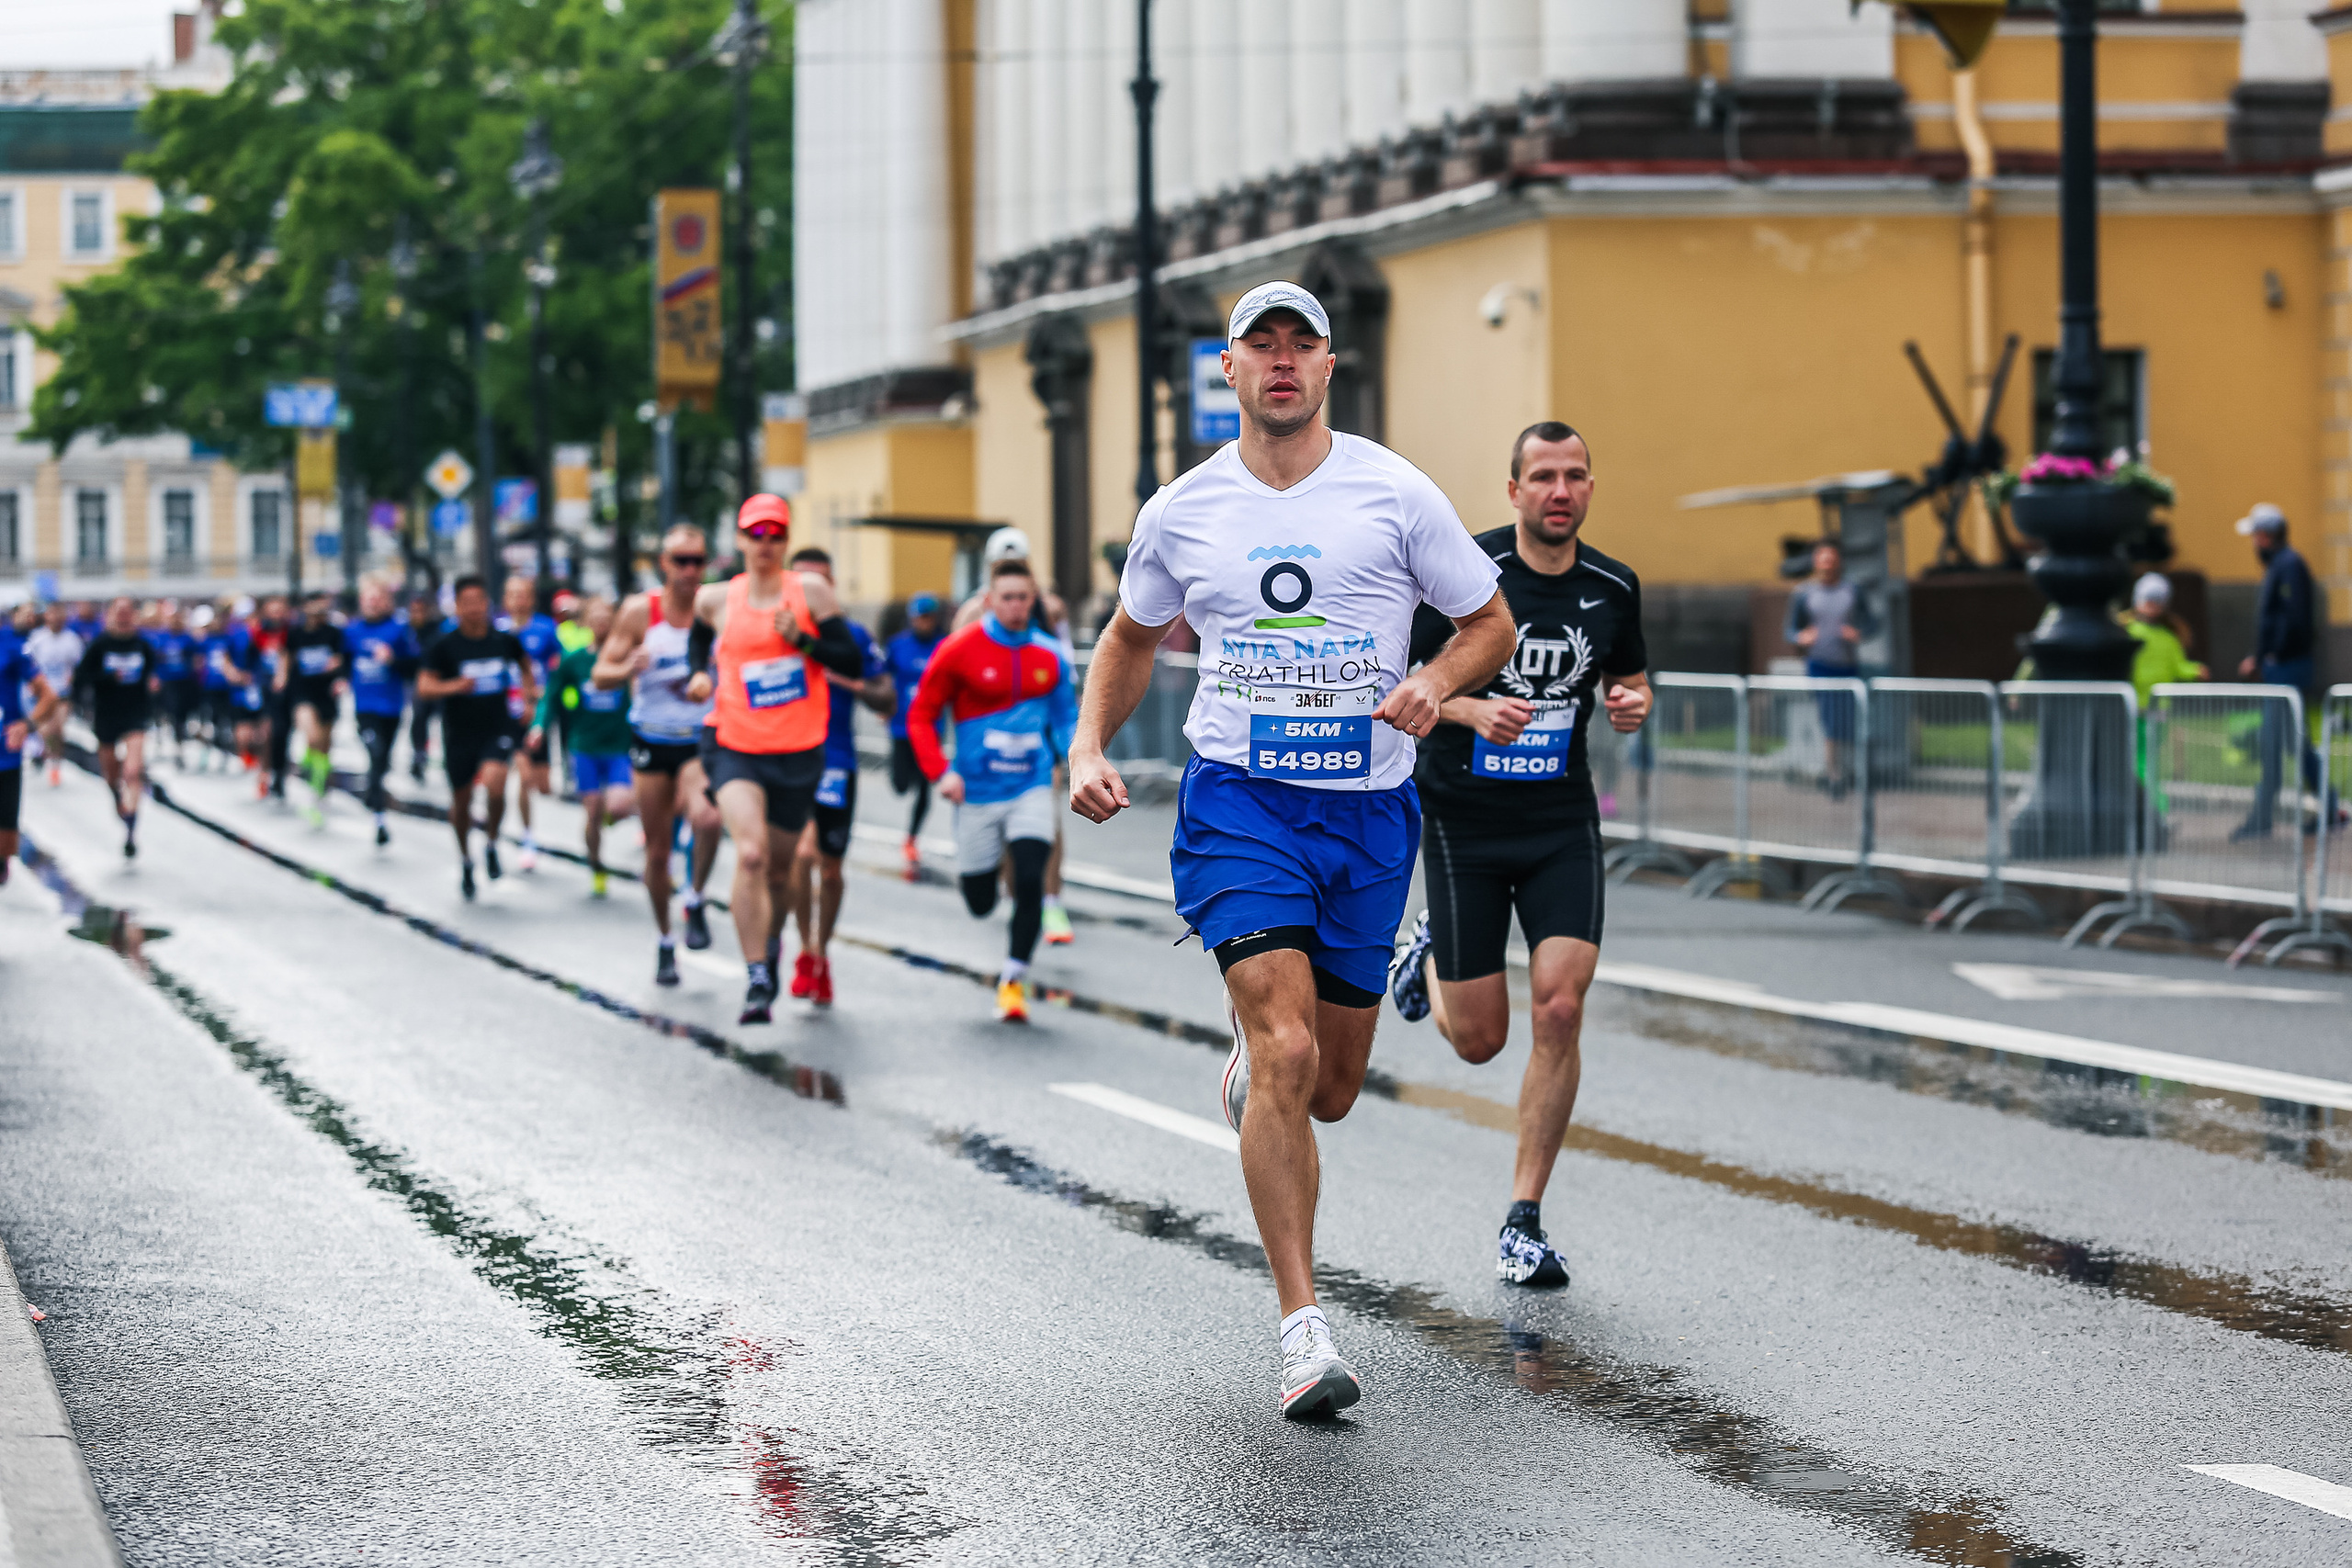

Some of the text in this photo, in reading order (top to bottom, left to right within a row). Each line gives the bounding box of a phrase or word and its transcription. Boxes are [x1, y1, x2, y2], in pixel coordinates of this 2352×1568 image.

[1222, 631, 1376, 660] AYIA NAPA
[1218, 656, 1381, 684] TRIATHLON
[1284, 722, 1342, 737] 5KM
[1510, 733, 1550, 747] KM
[1259, 750, 1363, 771] 54989
[1484, 754, 1559, 773] 51208
